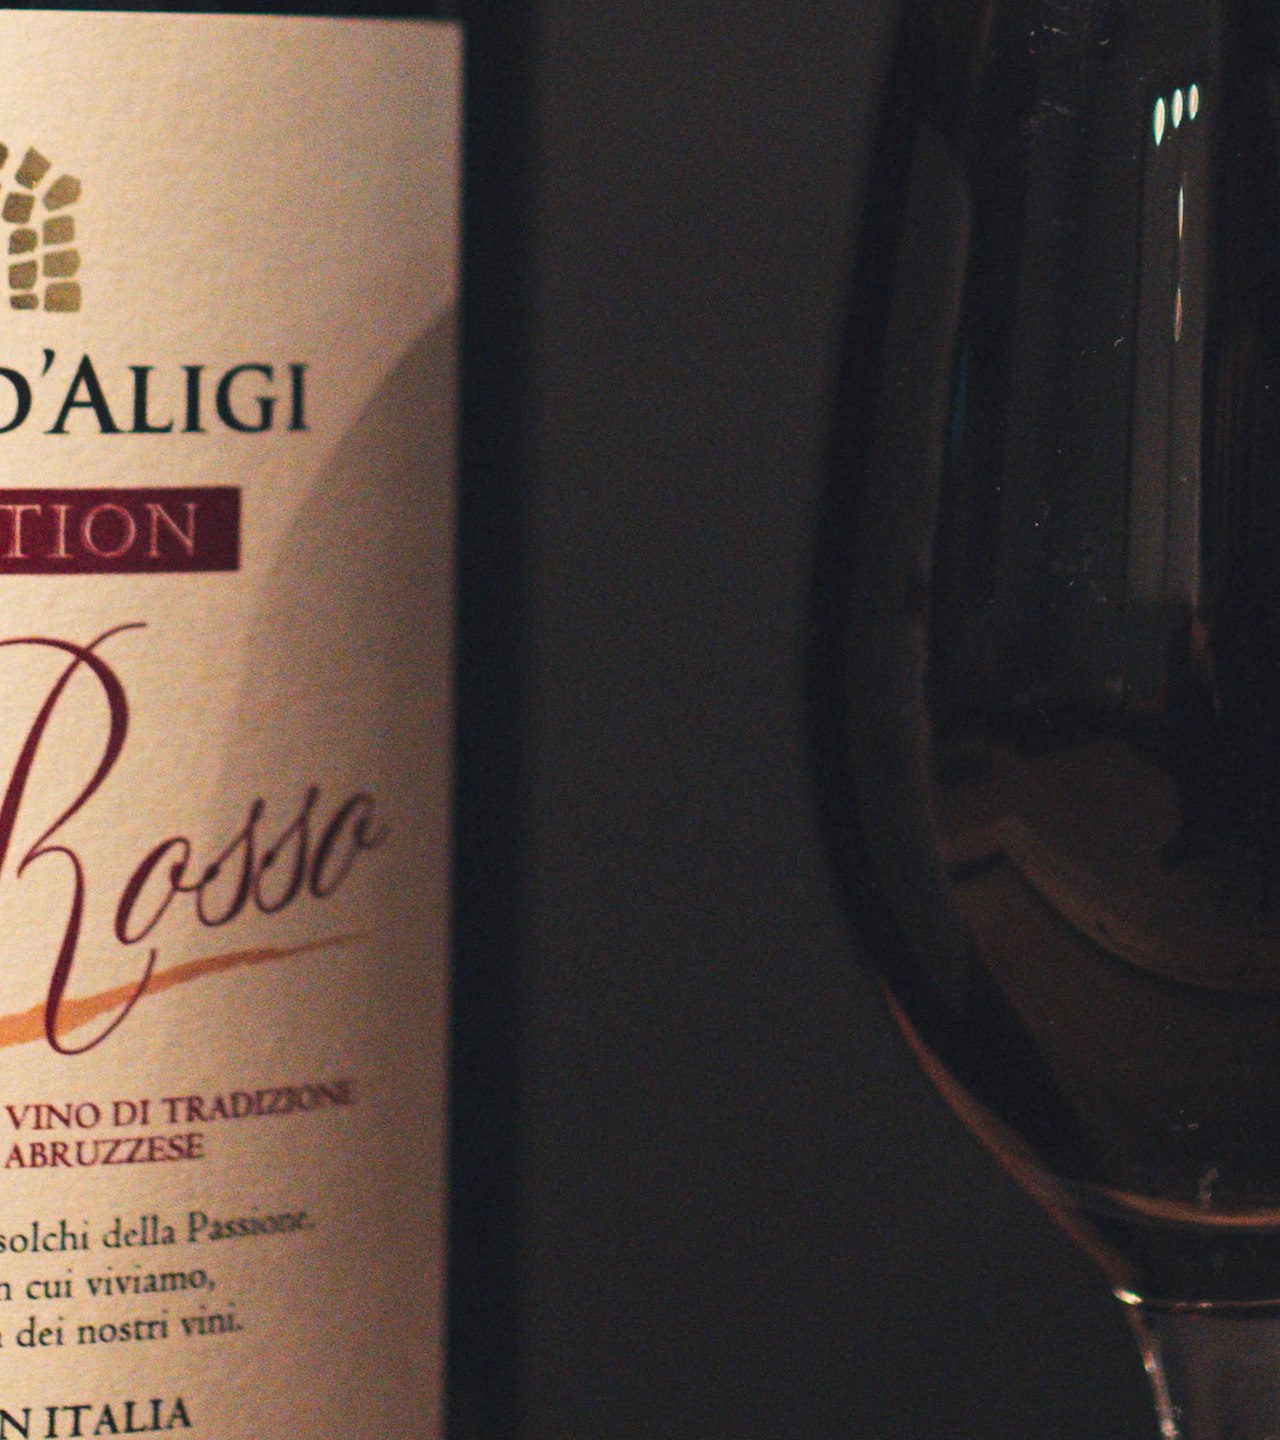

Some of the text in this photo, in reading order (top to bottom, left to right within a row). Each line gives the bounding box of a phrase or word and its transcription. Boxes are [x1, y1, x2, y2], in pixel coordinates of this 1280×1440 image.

[3, 1080, 353, 1132] VINO DI TRADIZIONE
[3, 1132, 205, 1169] ABRUZZESE
[102, 1215, 176, 1249] della
[25, 1269, 74, 1301] cui
[86, 1264, 217, 1297] viviamo,
[15, 1315, 66, 1349] dei
[76, 1310, 169, 1346] nostri
[180, 1301, 245, 1337] vini.
[44, 1396, 194, 1440] ITALIA
